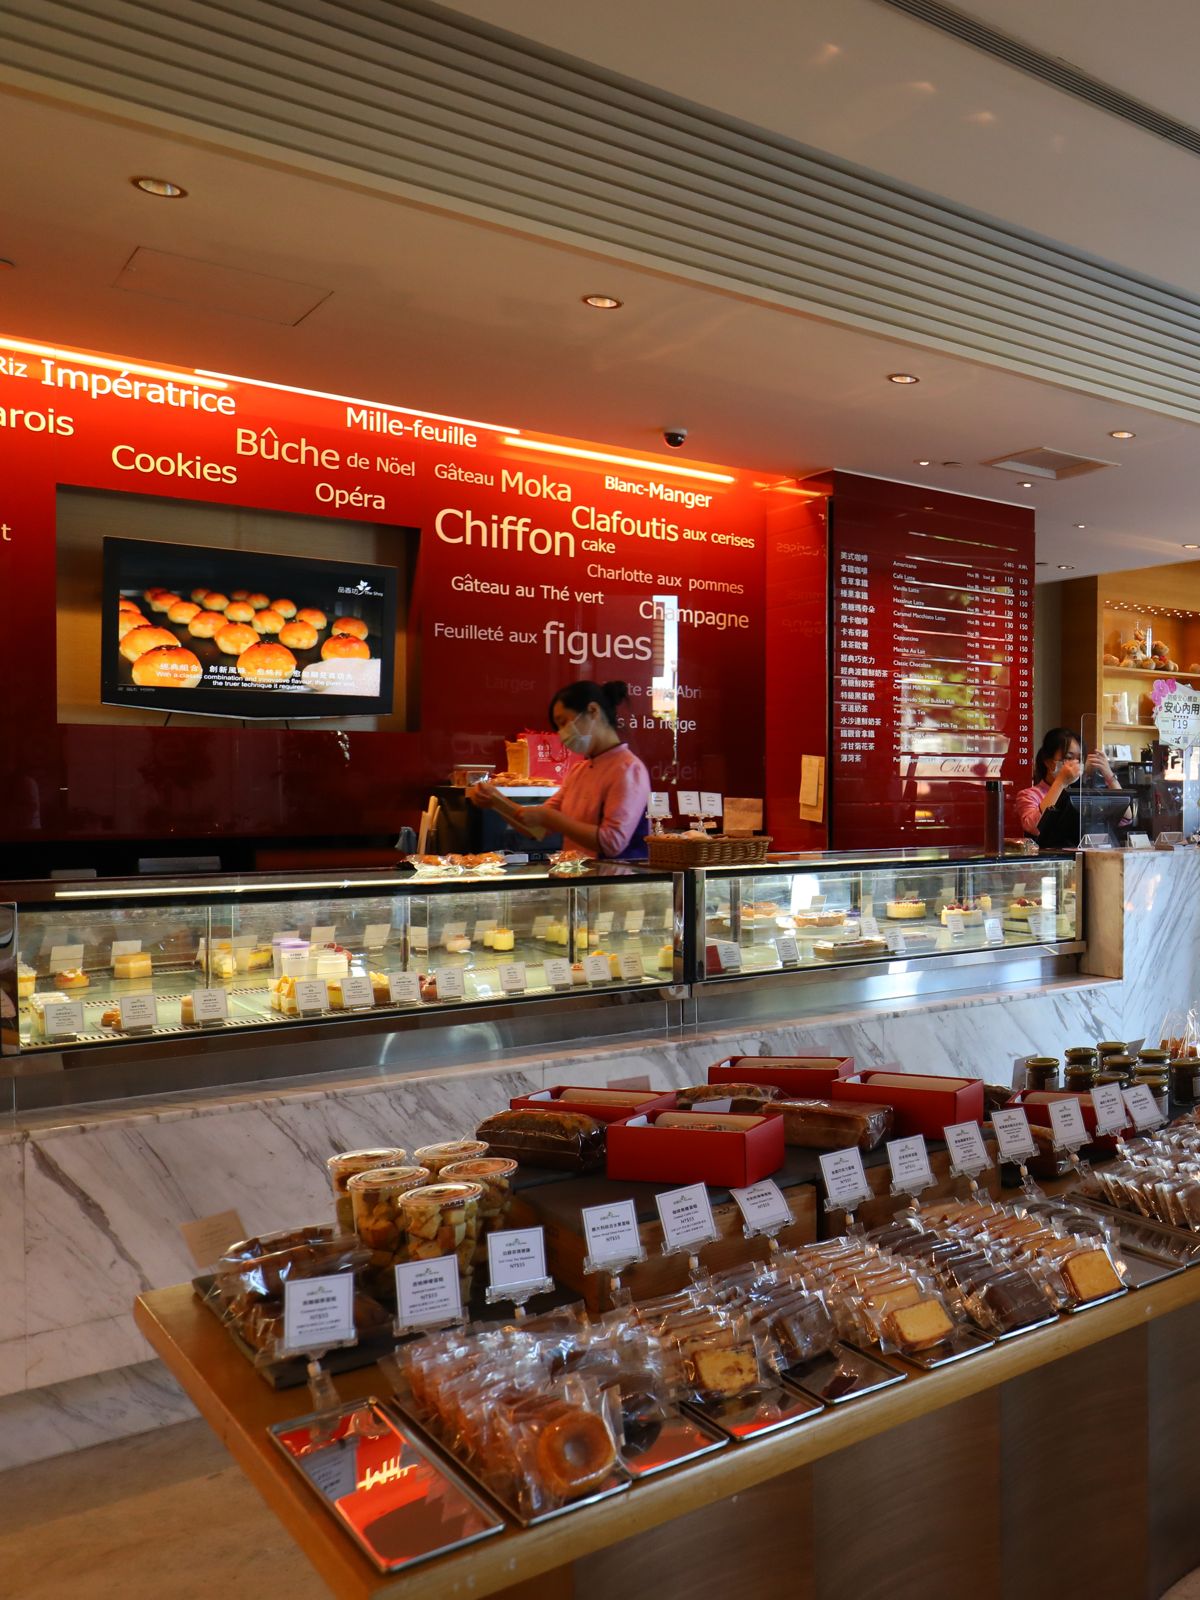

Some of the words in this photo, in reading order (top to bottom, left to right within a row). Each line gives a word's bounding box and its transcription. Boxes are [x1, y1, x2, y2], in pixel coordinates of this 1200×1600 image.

[41, 359, 236, 415] Impératrice
[347, 407, 477, 447] Mille-feuille
[111, 445, 238, 484] Cookies
[236, 427, 340, 469] Bûche
[347, 453, 370, 470] de
[376, 456, 415, 476] Nöel
[315, 483, 385, 510] Opéra
[435, 463, 494, 486] Gâteau
[502, 469, 571, 502] Moka
[605, 475, 712, 509] Blanc-Manger
[435, 508, 575, 558] Chiffon
[581, 538, 616, 554] cake
[572, 506, 679, 542] Clafoutis
[683, 527, 707, 542] aux
[711, 532, 755, 549] cerises
[451, 574, 510, 596] Gâteau
[515, 585, 535, 598] au
[540, 584, 570, 601] Thé
[574, 590, 604, 605] vert
[587, 563, 653, 584] Charlotte
[657, 573, 682, 587] aux
[688, 577, 744, 595] pommes
[639, 600, 750, 630] Champagne
[434, 622, 504, 642] Feuilleté
[509, 630, 538, 644] aux
[543, 620, 652, 665] figues
[203, 674, 243, 684] combination
[241, 681, 275, 690] technique
[643, 716, 655, 729] la
[660, 717, 696, 734] neige
[1171, 719, 1188, 729] T19
